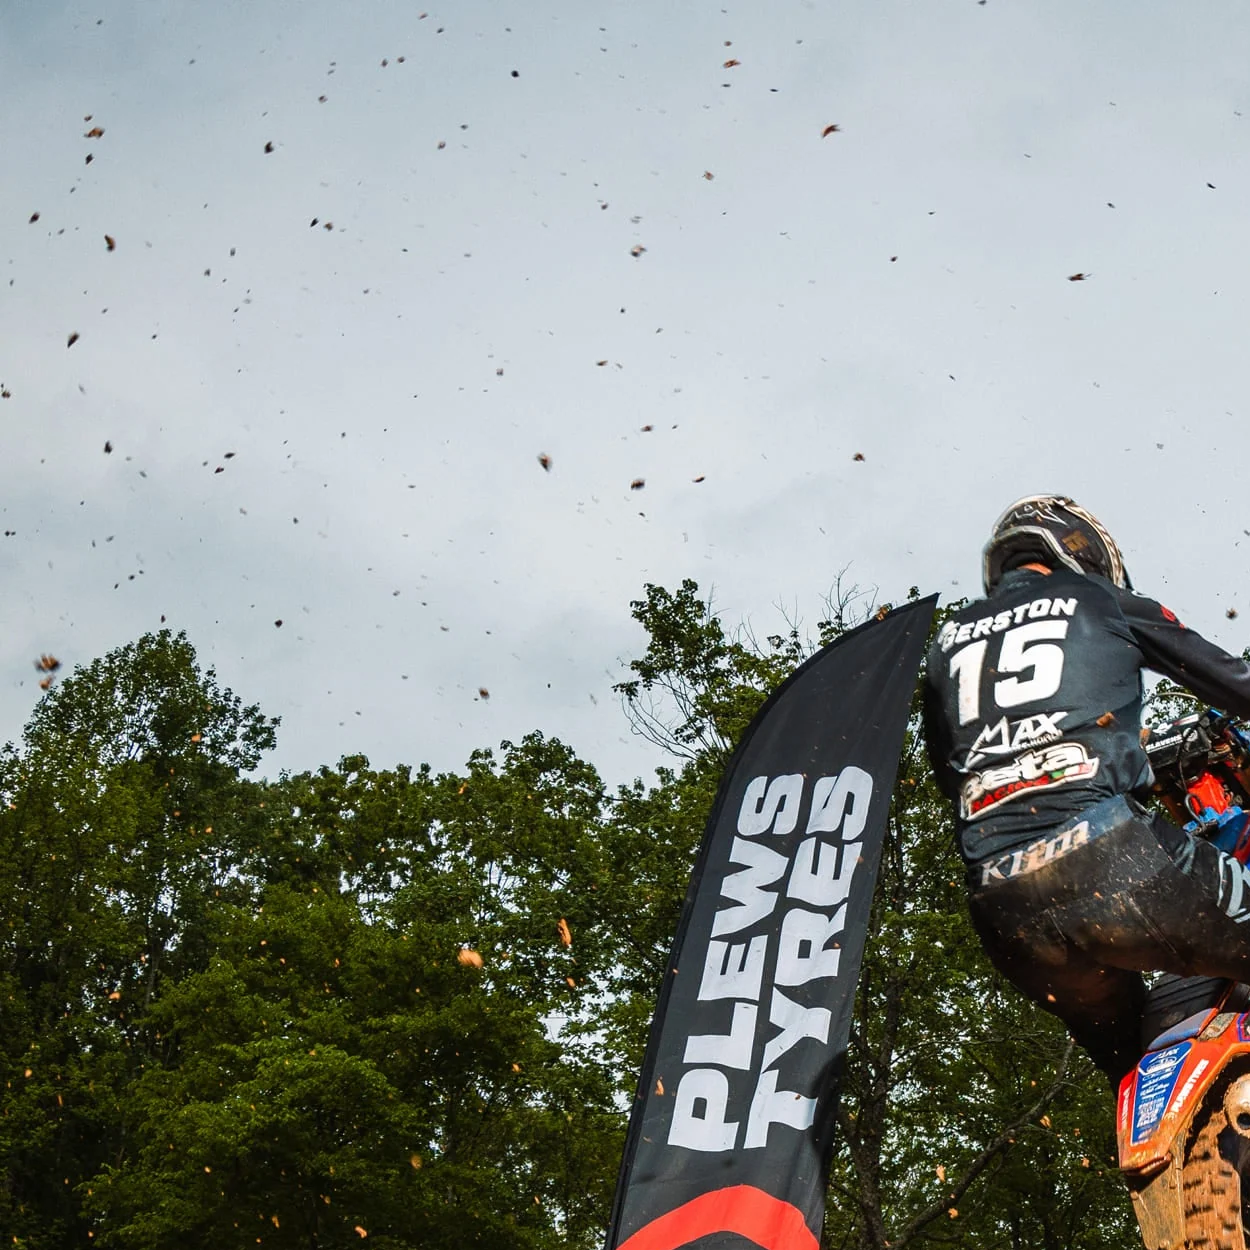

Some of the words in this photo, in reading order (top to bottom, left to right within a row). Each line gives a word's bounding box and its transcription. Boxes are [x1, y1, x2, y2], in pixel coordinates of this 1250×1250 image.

[949, 619, 1069, 727] 15
[963, 711, 1068, 772] MAX
[667, 773, 804, 1152] PLEWS
[743, 765, 873, 1150] TYRES
